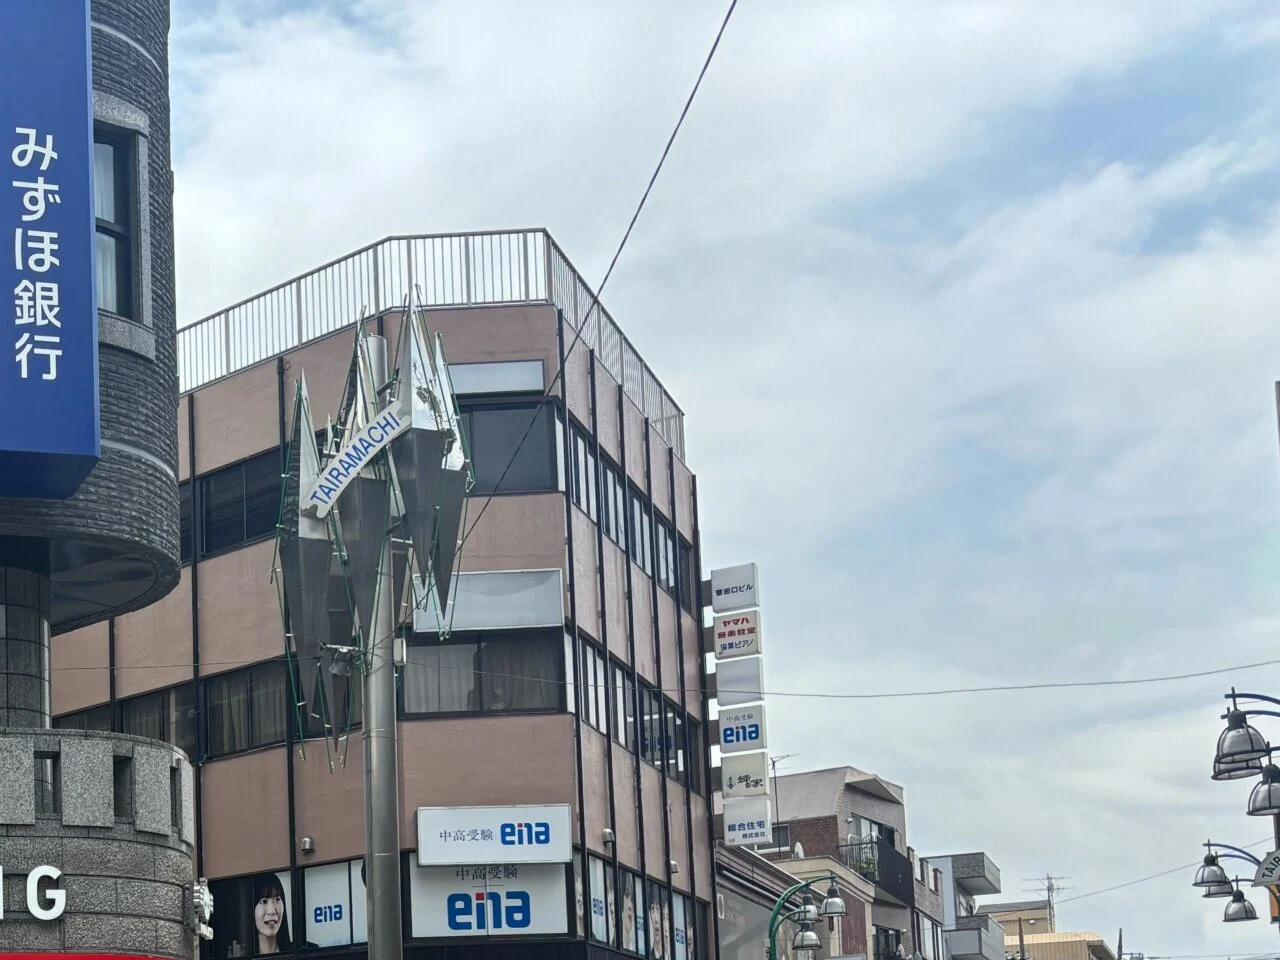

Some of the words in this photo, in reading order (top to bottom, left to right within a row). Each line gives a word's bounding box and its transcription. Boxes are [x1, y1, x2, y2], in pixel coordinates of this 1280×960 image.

[11, 126, 63, 381] みずほ銀行
[310, 411, 401, 505] TAIRAMACHI
[717, 626, 756, 639] 音楽教室
[722, 617, 750, 628] ヤマハ
[723, 723, 760, 744] ena
[439, 829, 495, 842] 中高受験
[500, 822, 550, 846] ena
[727, 820, 766, 832] 総合住宅
[742, 831, 766, 839] 株式会社
[455, 864, 520, 881] 中高受験
[313, 904, 343, 924] ena
[447, 890, 531, 931] ena
